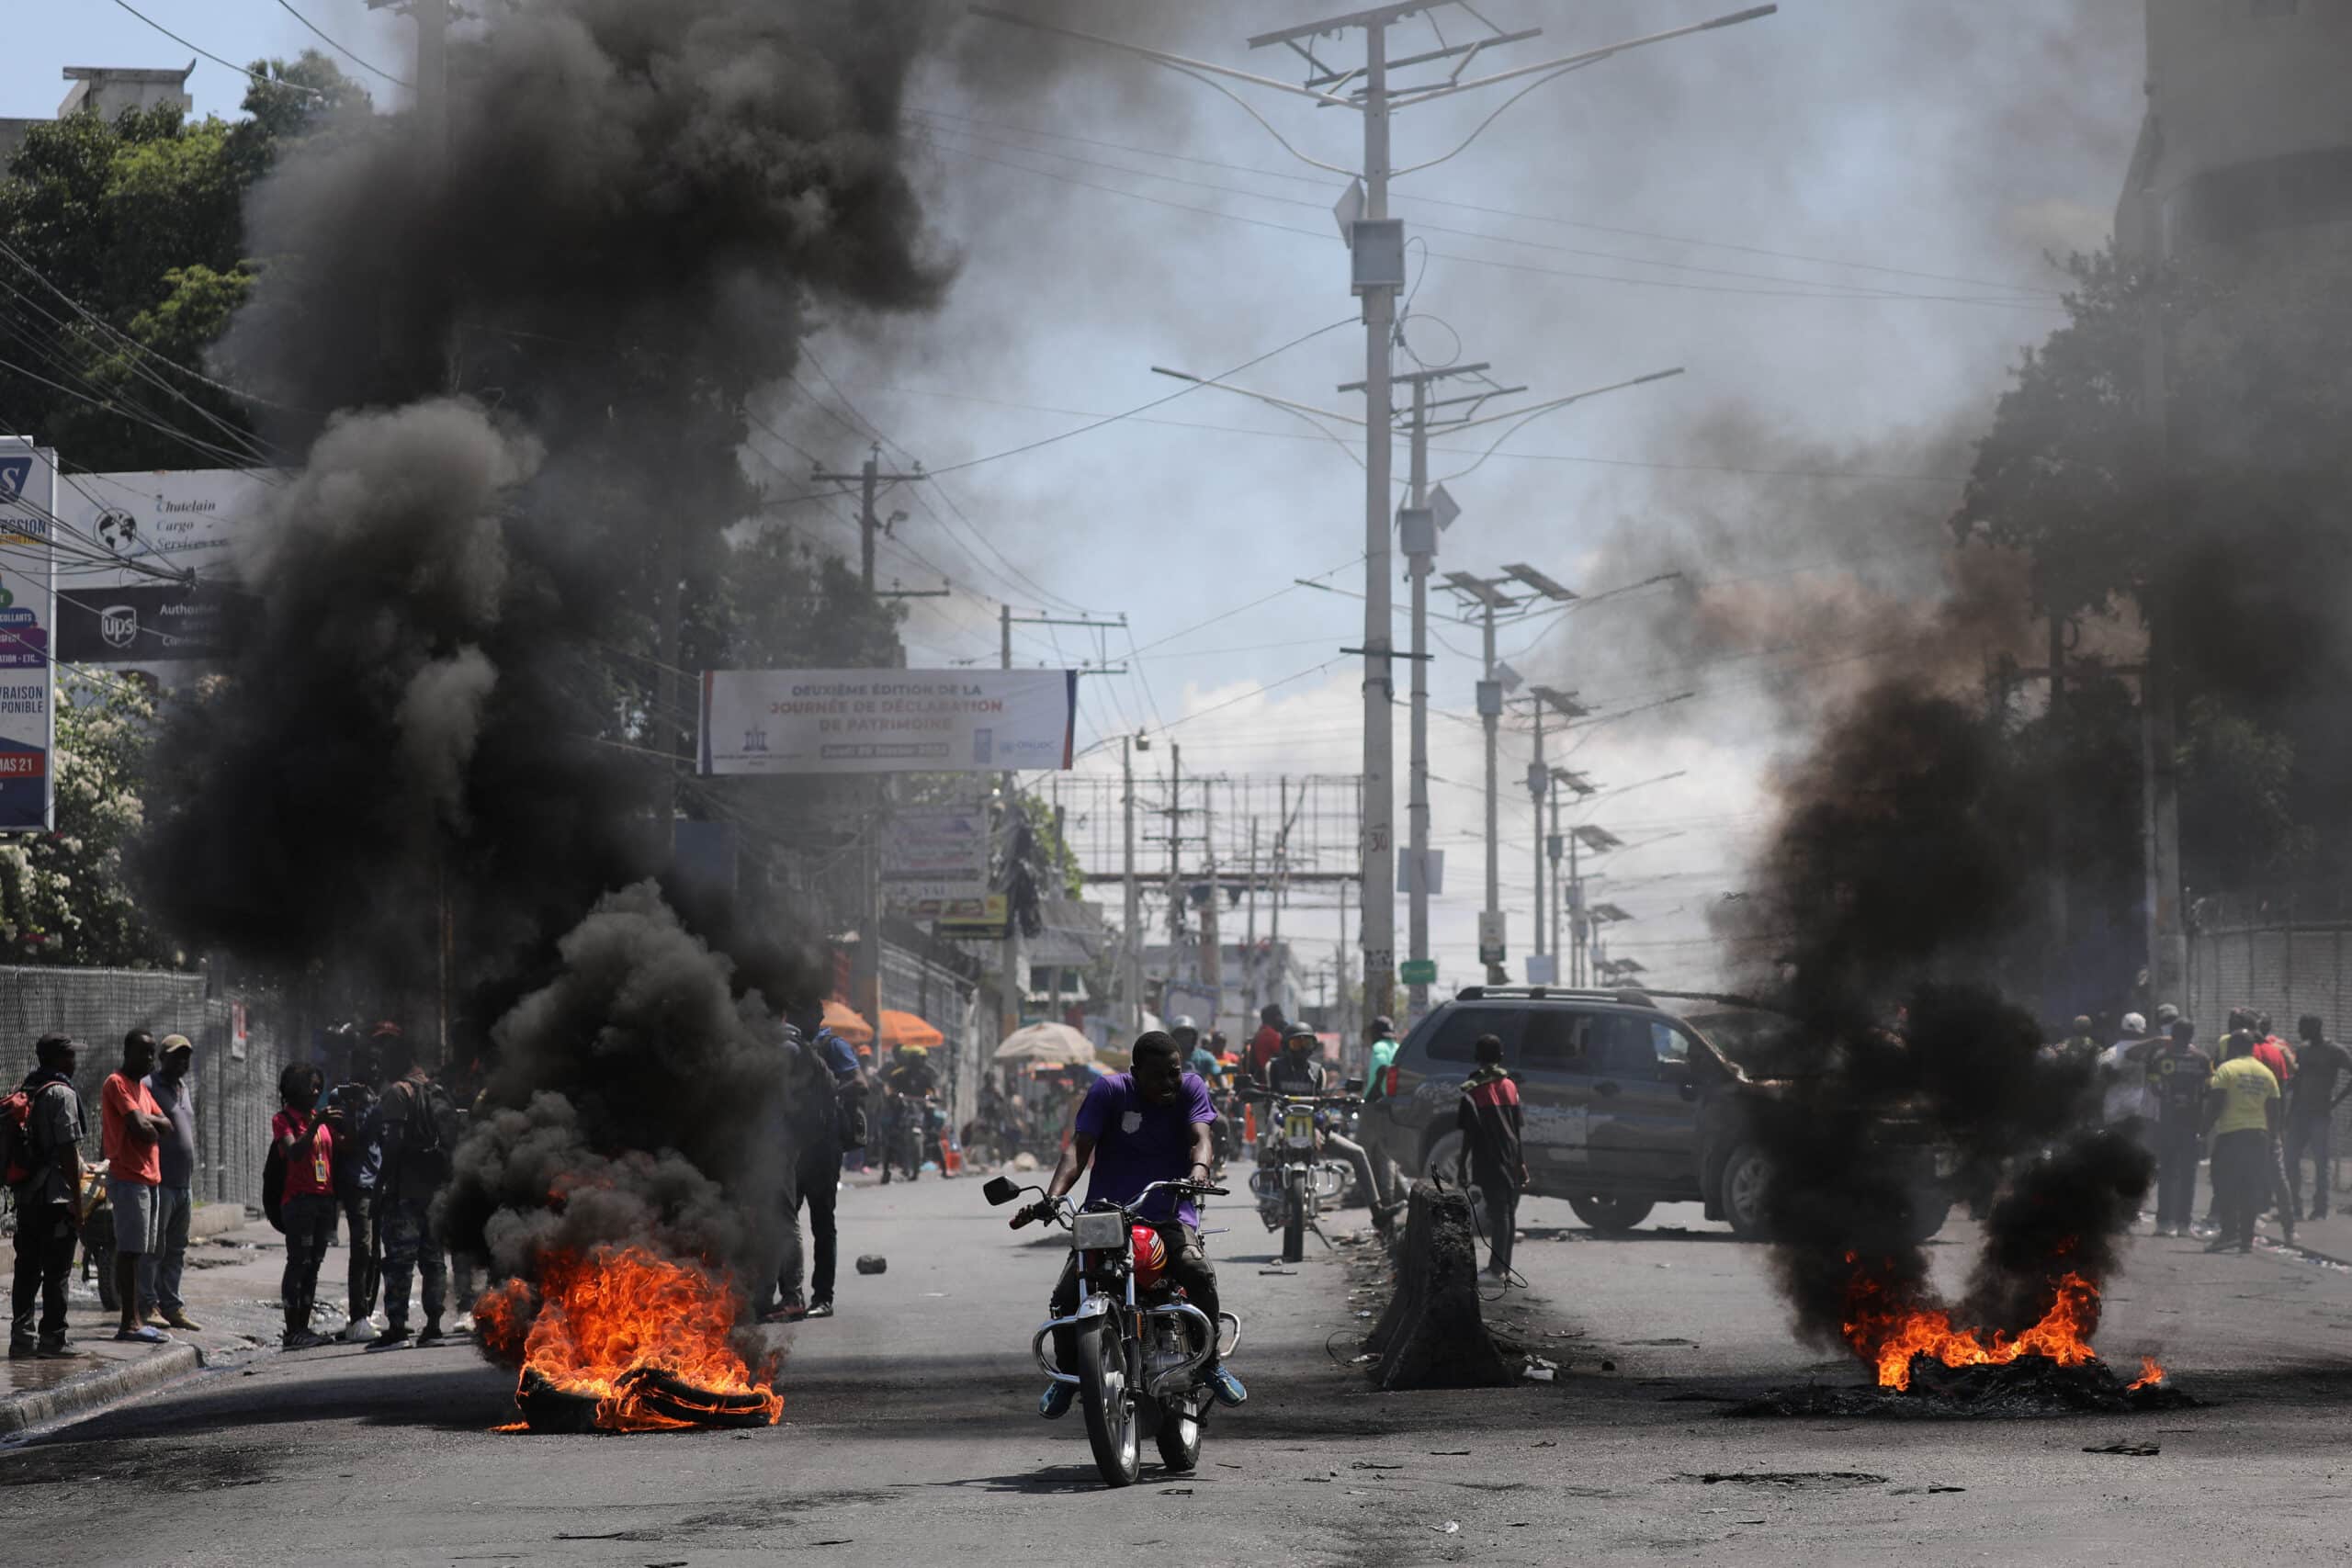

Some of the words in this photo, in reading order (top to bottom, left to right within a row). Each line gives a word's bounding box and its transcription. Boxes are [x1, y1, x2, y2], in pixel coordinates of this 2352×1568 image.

[104, 617, 135, 641] ups
[938, 684, 958, 696] DE
[963, 684, 982, 696] LA
[854, 701, 875, 713] DE
